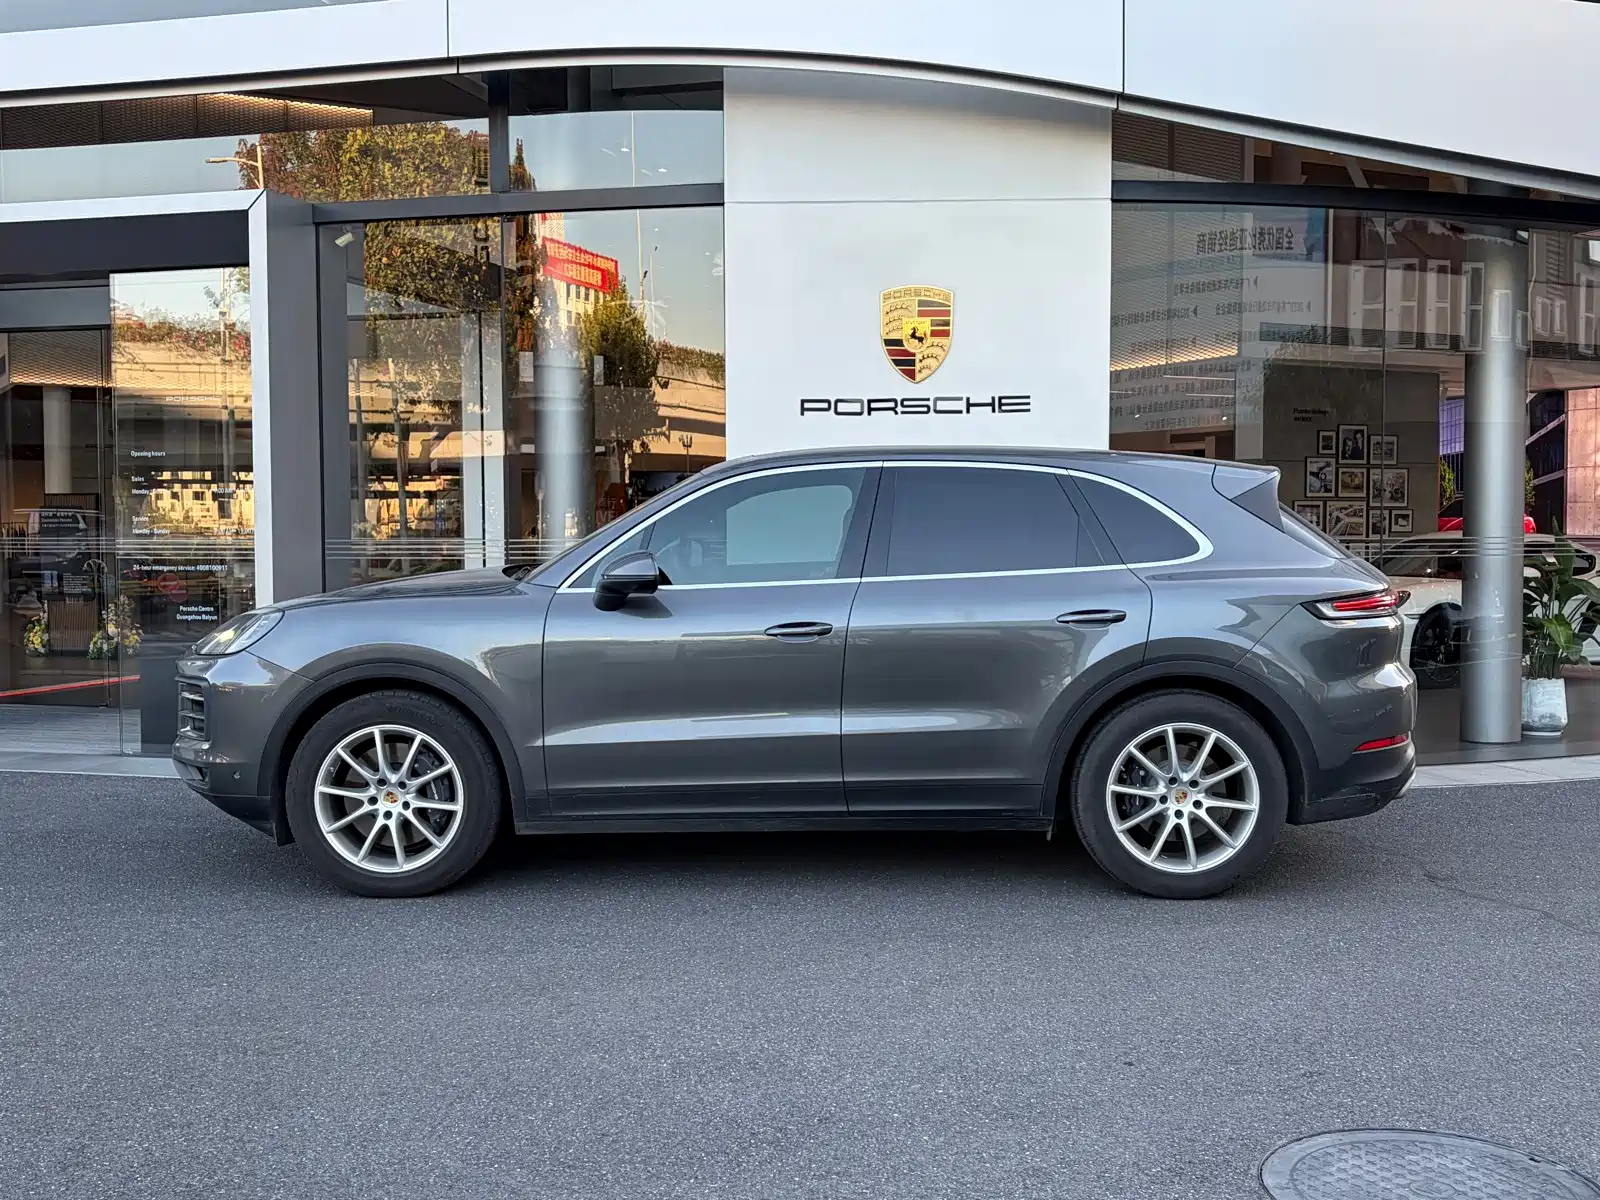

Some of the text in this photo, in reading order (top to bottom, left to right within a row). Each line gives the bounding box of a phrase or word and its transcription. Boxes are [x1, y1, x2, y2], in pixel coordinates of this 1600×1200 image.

[800, 395, 1031, 416] PORSCHE
[130, 450, 152, 458] Opening
[152, 564, 178, 572] emergency
